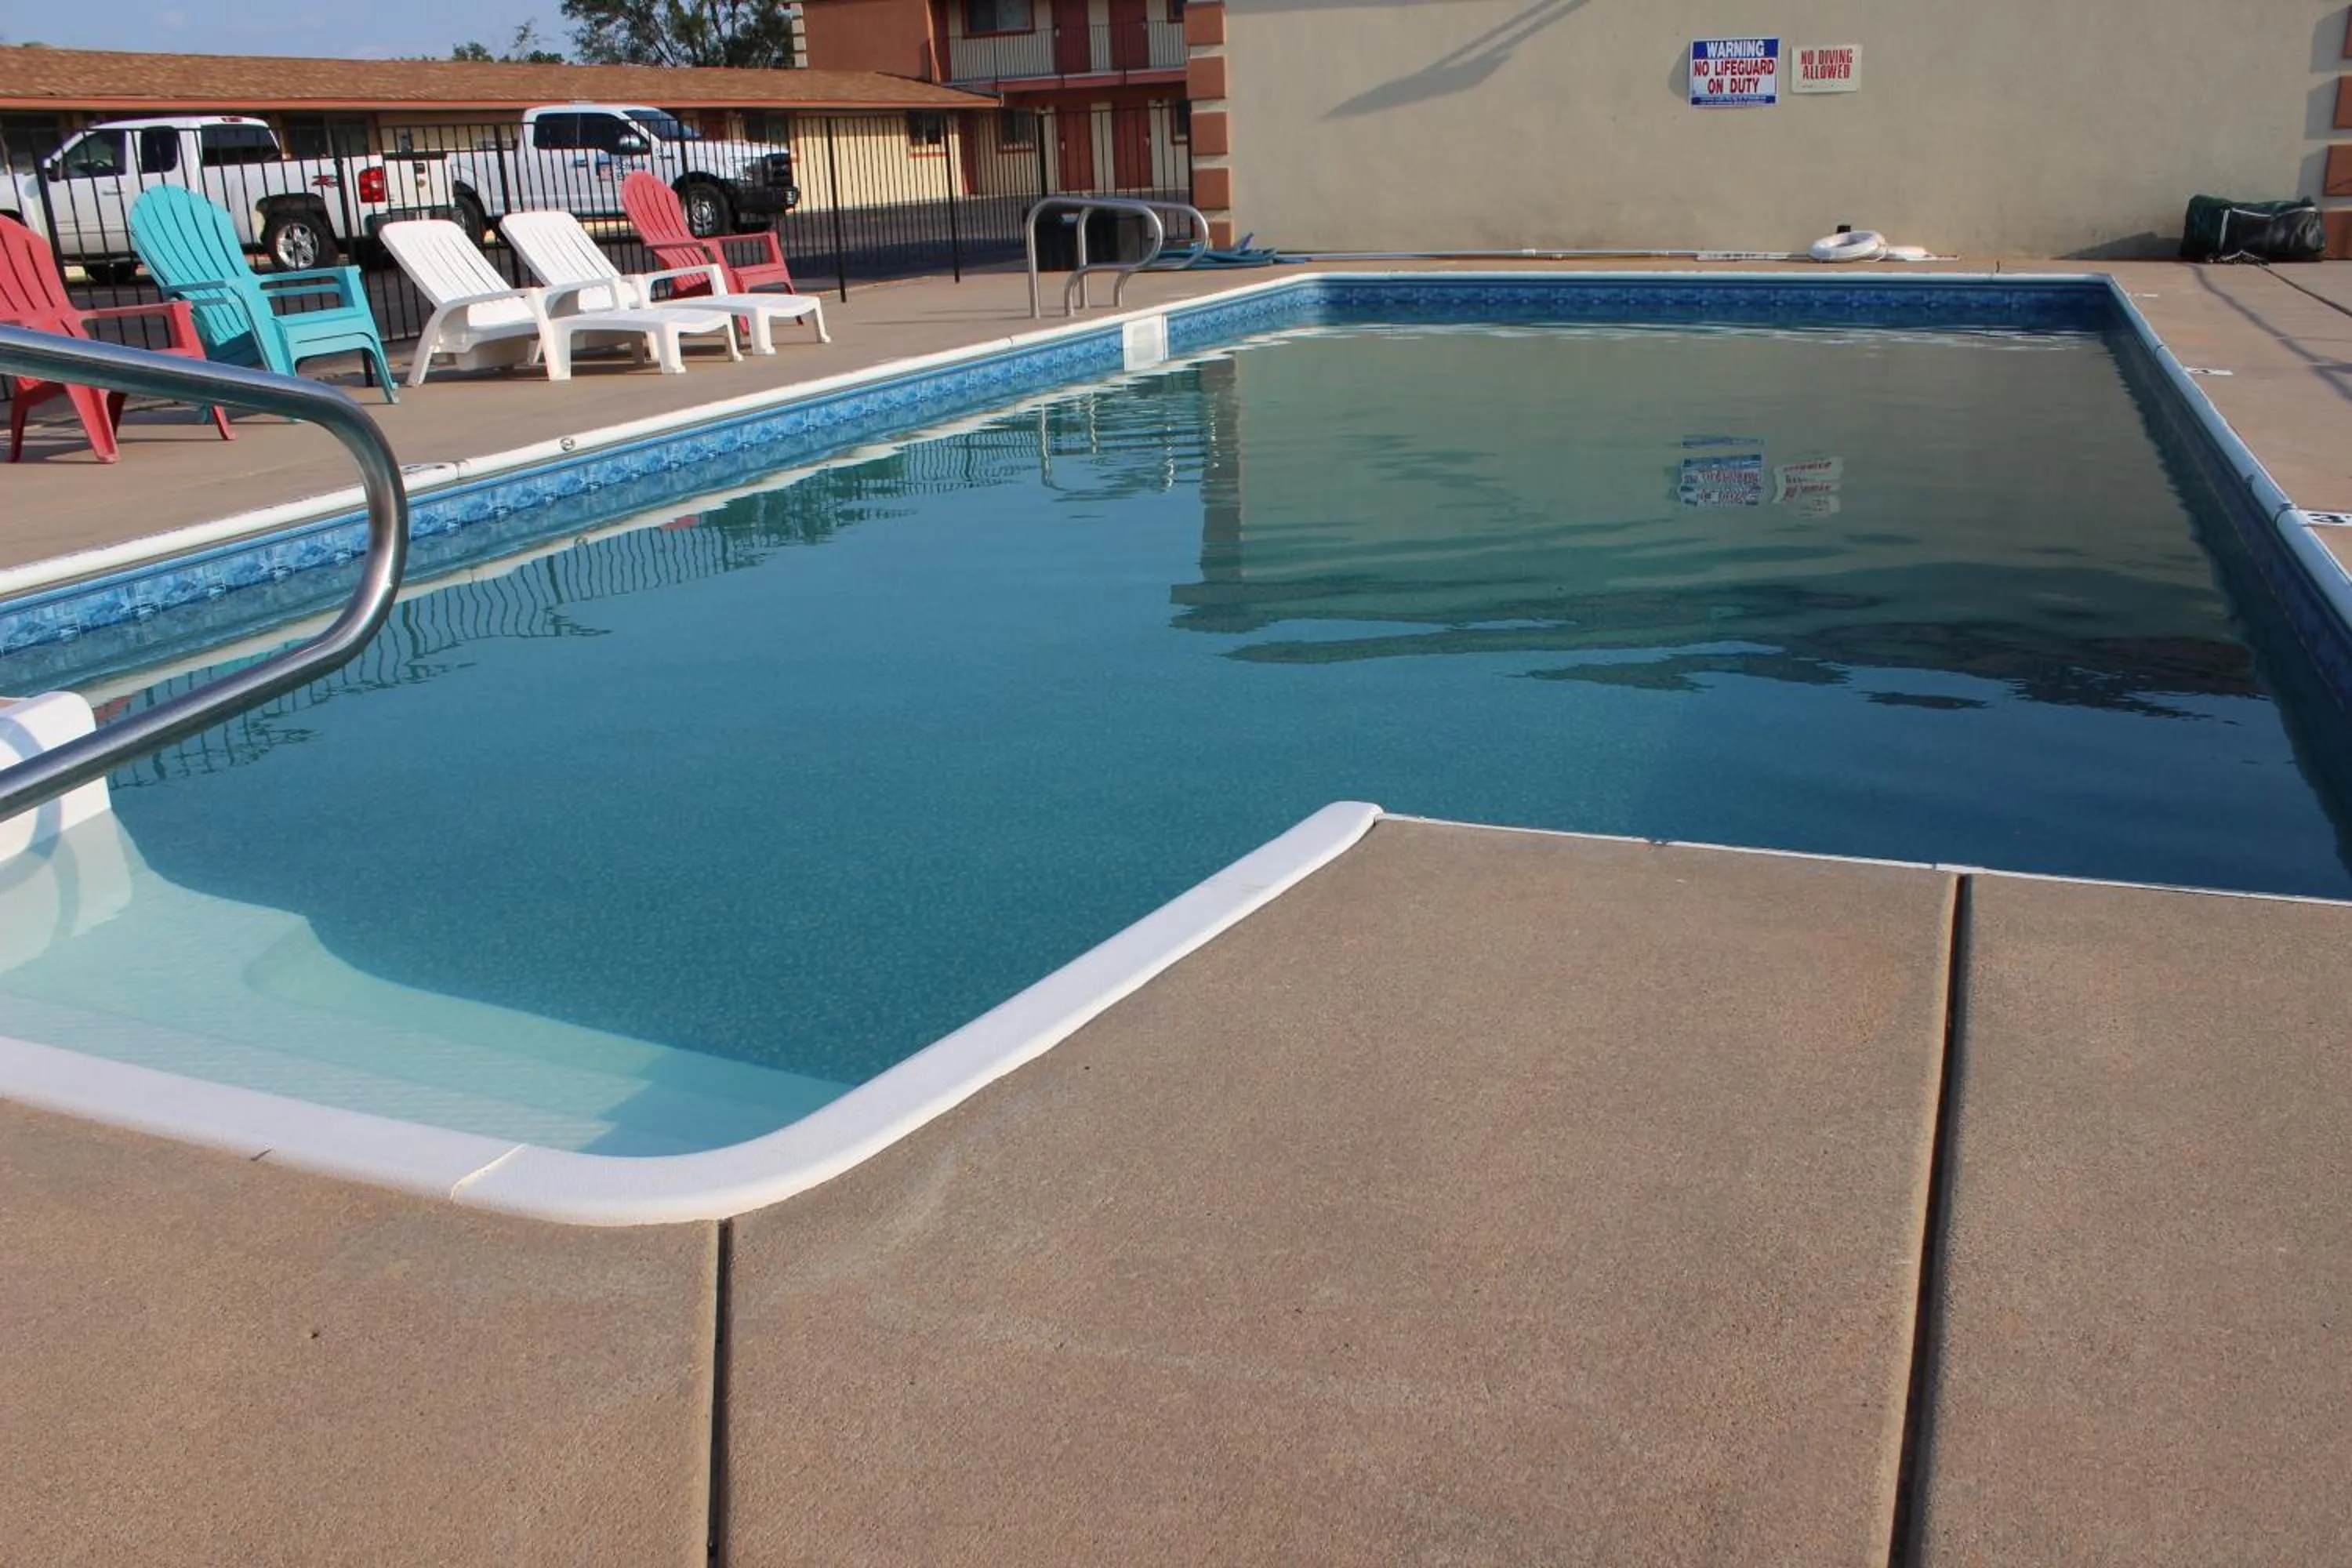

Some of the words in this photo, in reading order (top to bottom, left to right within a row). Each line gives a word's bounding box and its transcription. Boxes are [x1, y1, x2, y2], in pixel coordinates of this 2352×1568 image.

[1706, 41, 1765, 58] WARNING
[1801, 49, 1813, 64] NO
[1819, 49, 1853, 64] DIVING
[1694, 61, 1709, 76] NO
[1715, 60, 1775, 76] LIFEGUARD
[1802, 64, 1850, 80] ALLOWED
[1708, 78, 1723, 94] ON
[1730, 78, 1759, 93] DUTY
